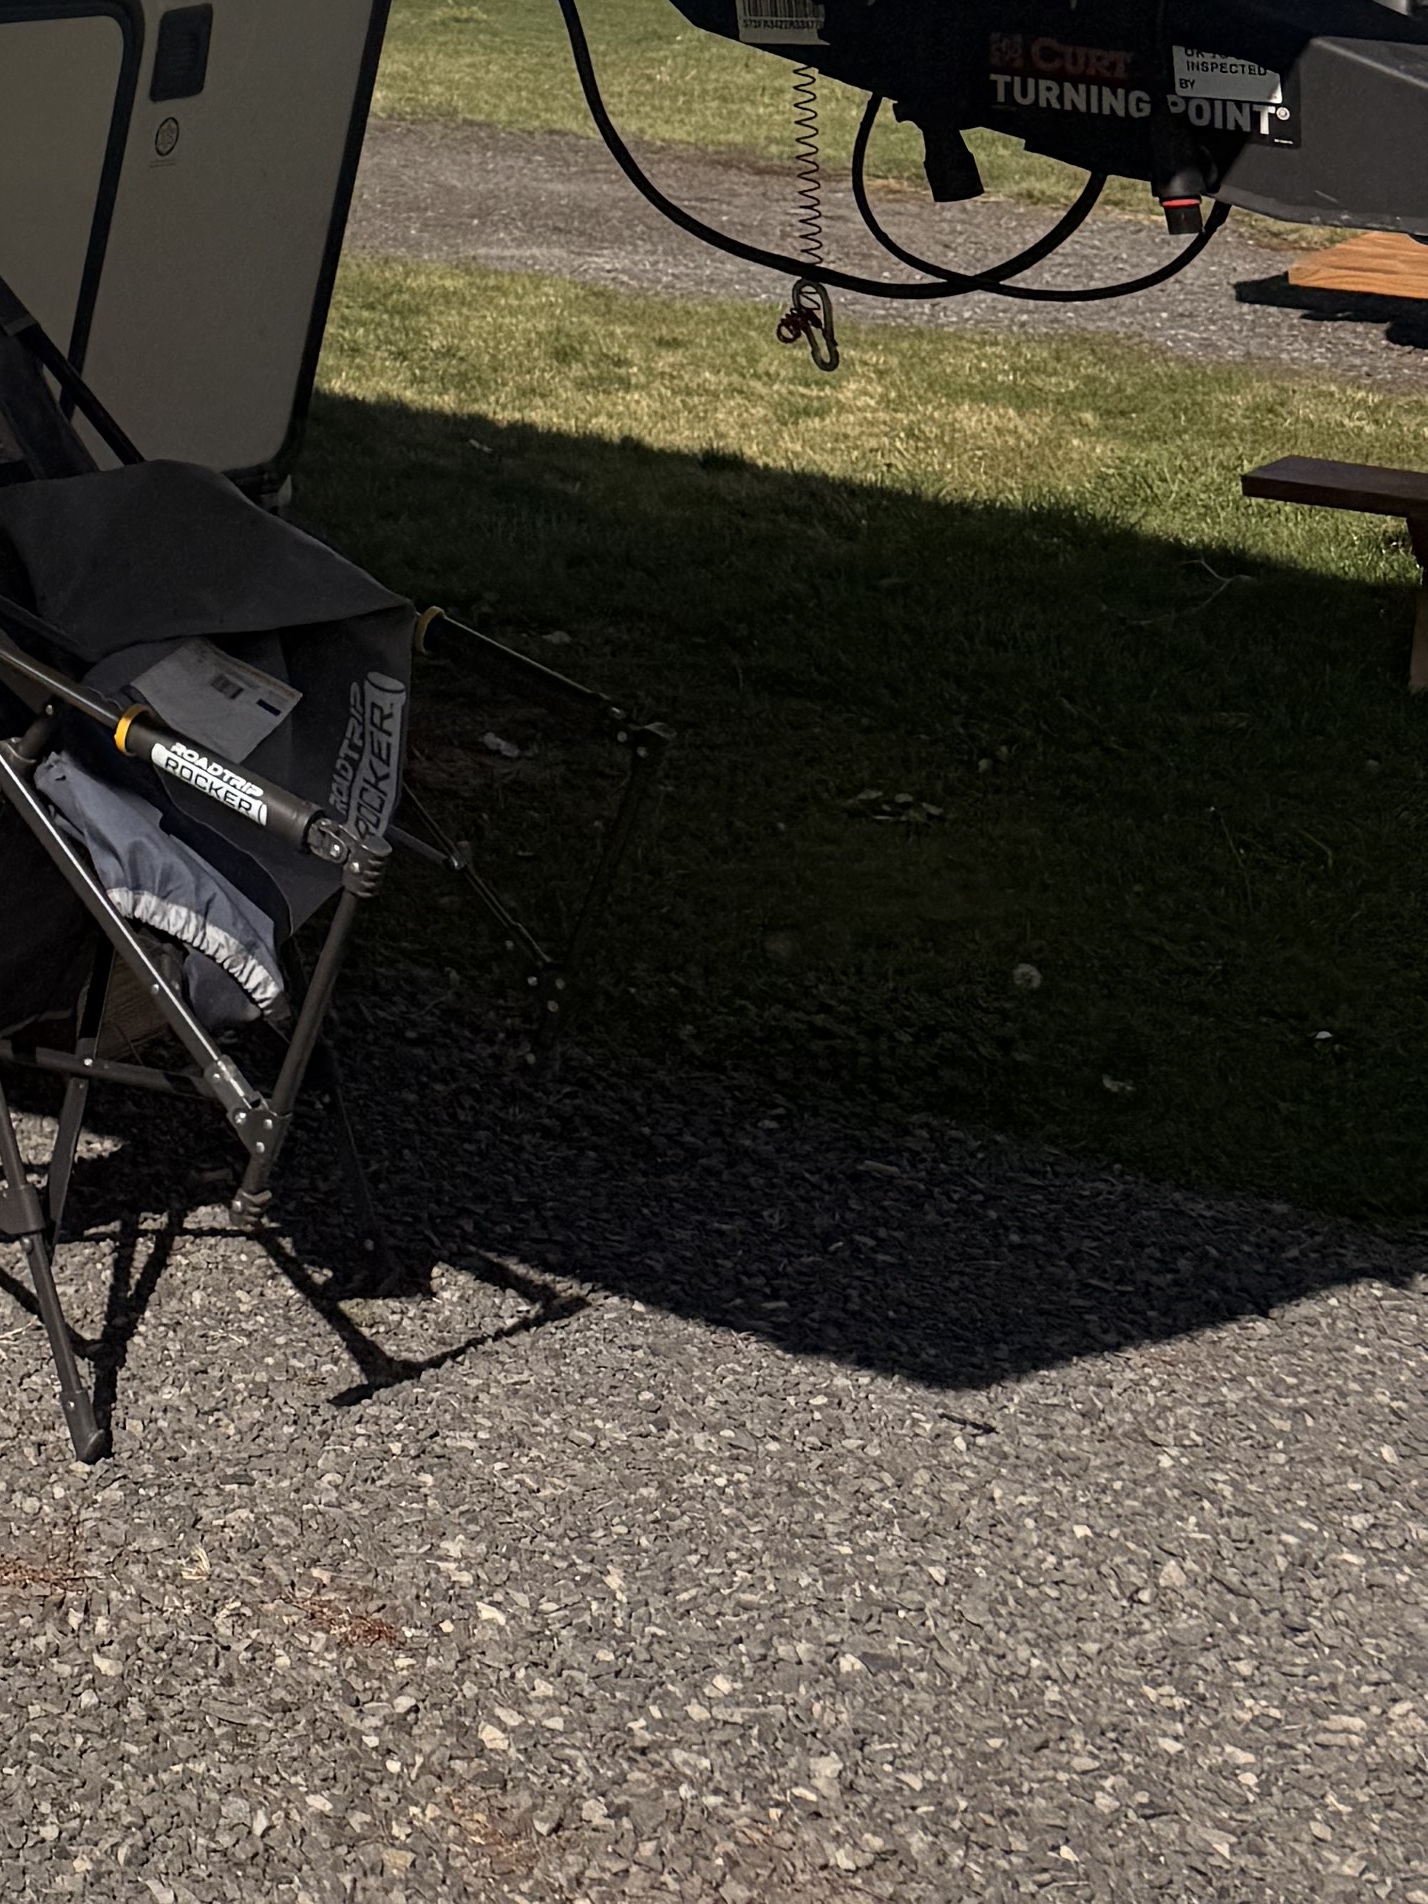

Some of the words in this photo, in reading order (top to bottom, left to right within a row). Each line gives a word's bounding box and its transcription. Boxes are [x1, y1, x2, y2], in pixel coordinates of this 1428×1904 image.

[1179, 78, 1197, 91] BY
[1186, 60, 1268, 77] INSPECTED
[989, 72, 1152, 119] TURNING
[165, 755, 253, 817] ROCKER
[170, 741, 264, 798] ROADTRIP
